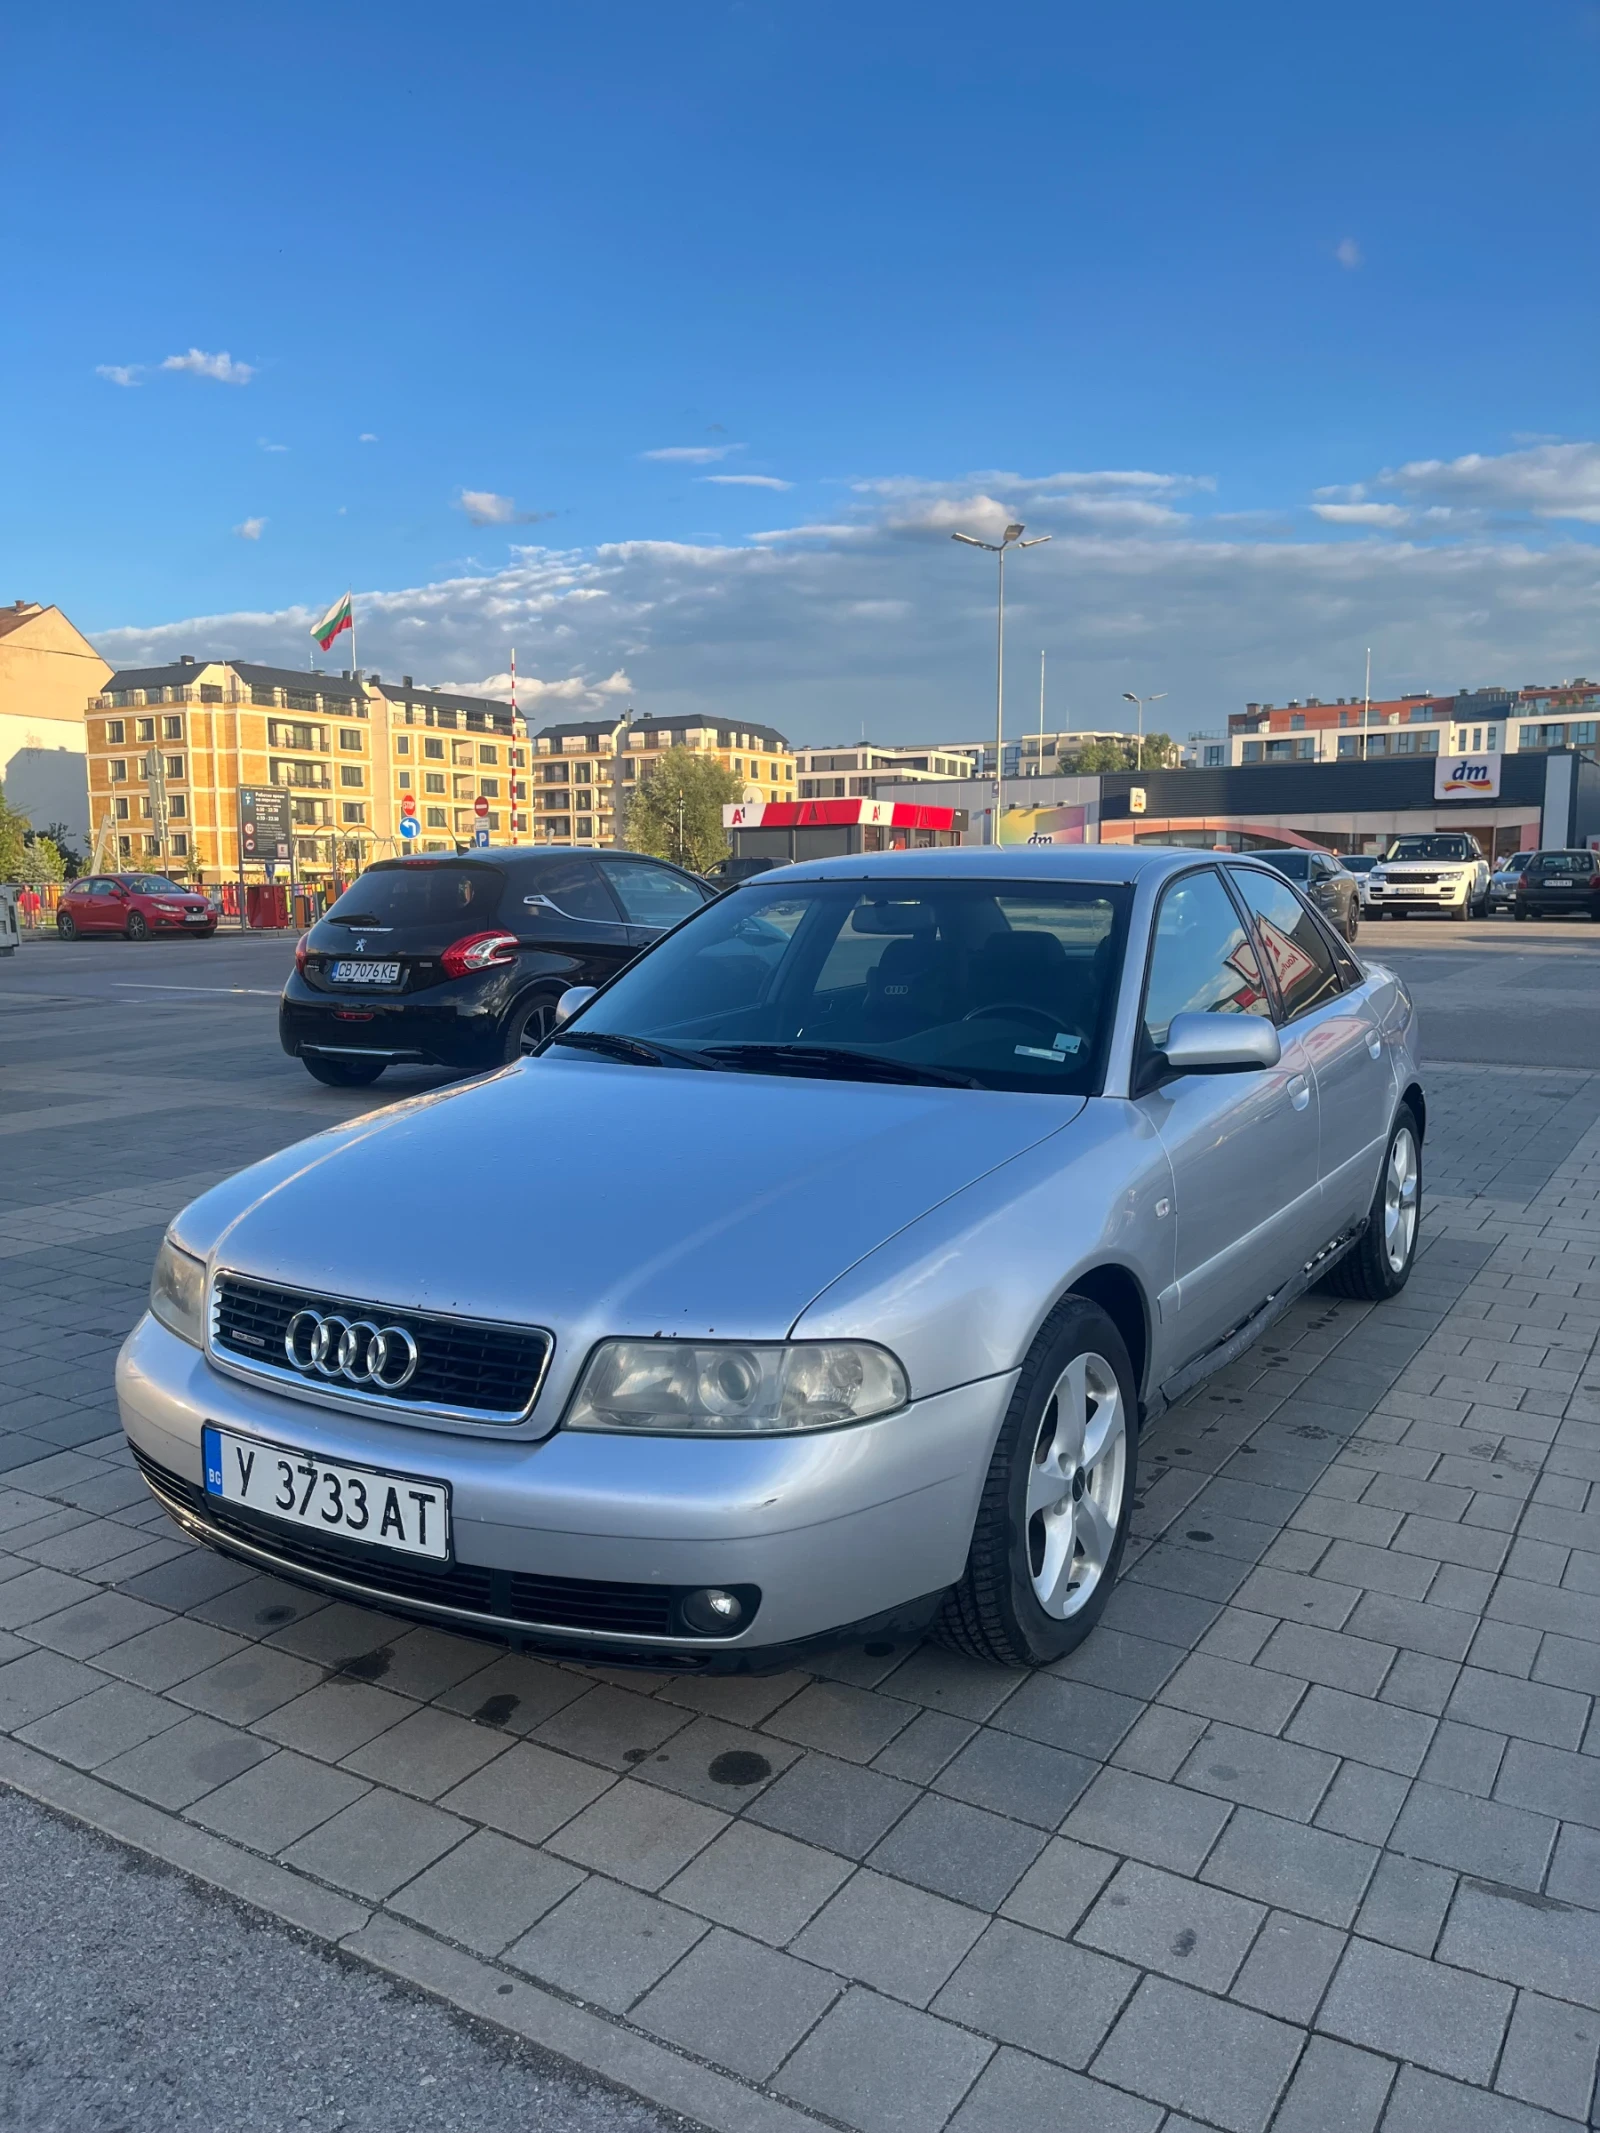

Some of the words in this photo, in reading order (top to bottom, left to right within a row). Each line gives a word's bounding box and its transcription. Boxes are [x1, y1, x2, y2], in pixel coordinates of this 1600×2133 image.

[1451, 760, 1487, 780] dm
[731, 806, 746, 825] A1
[872, 804, 881, 822] A1
[1027, 832, 1052, 844] dm
[338, 963, 352, 977] CB
[353, 963, 379, 978] 7076
[381, 964, 398, 979] KE
[208, 1468, 222, 1485] BG
[275, 1460, 369, 1530] 3733
[380, 1486, 436, 1546] AT
